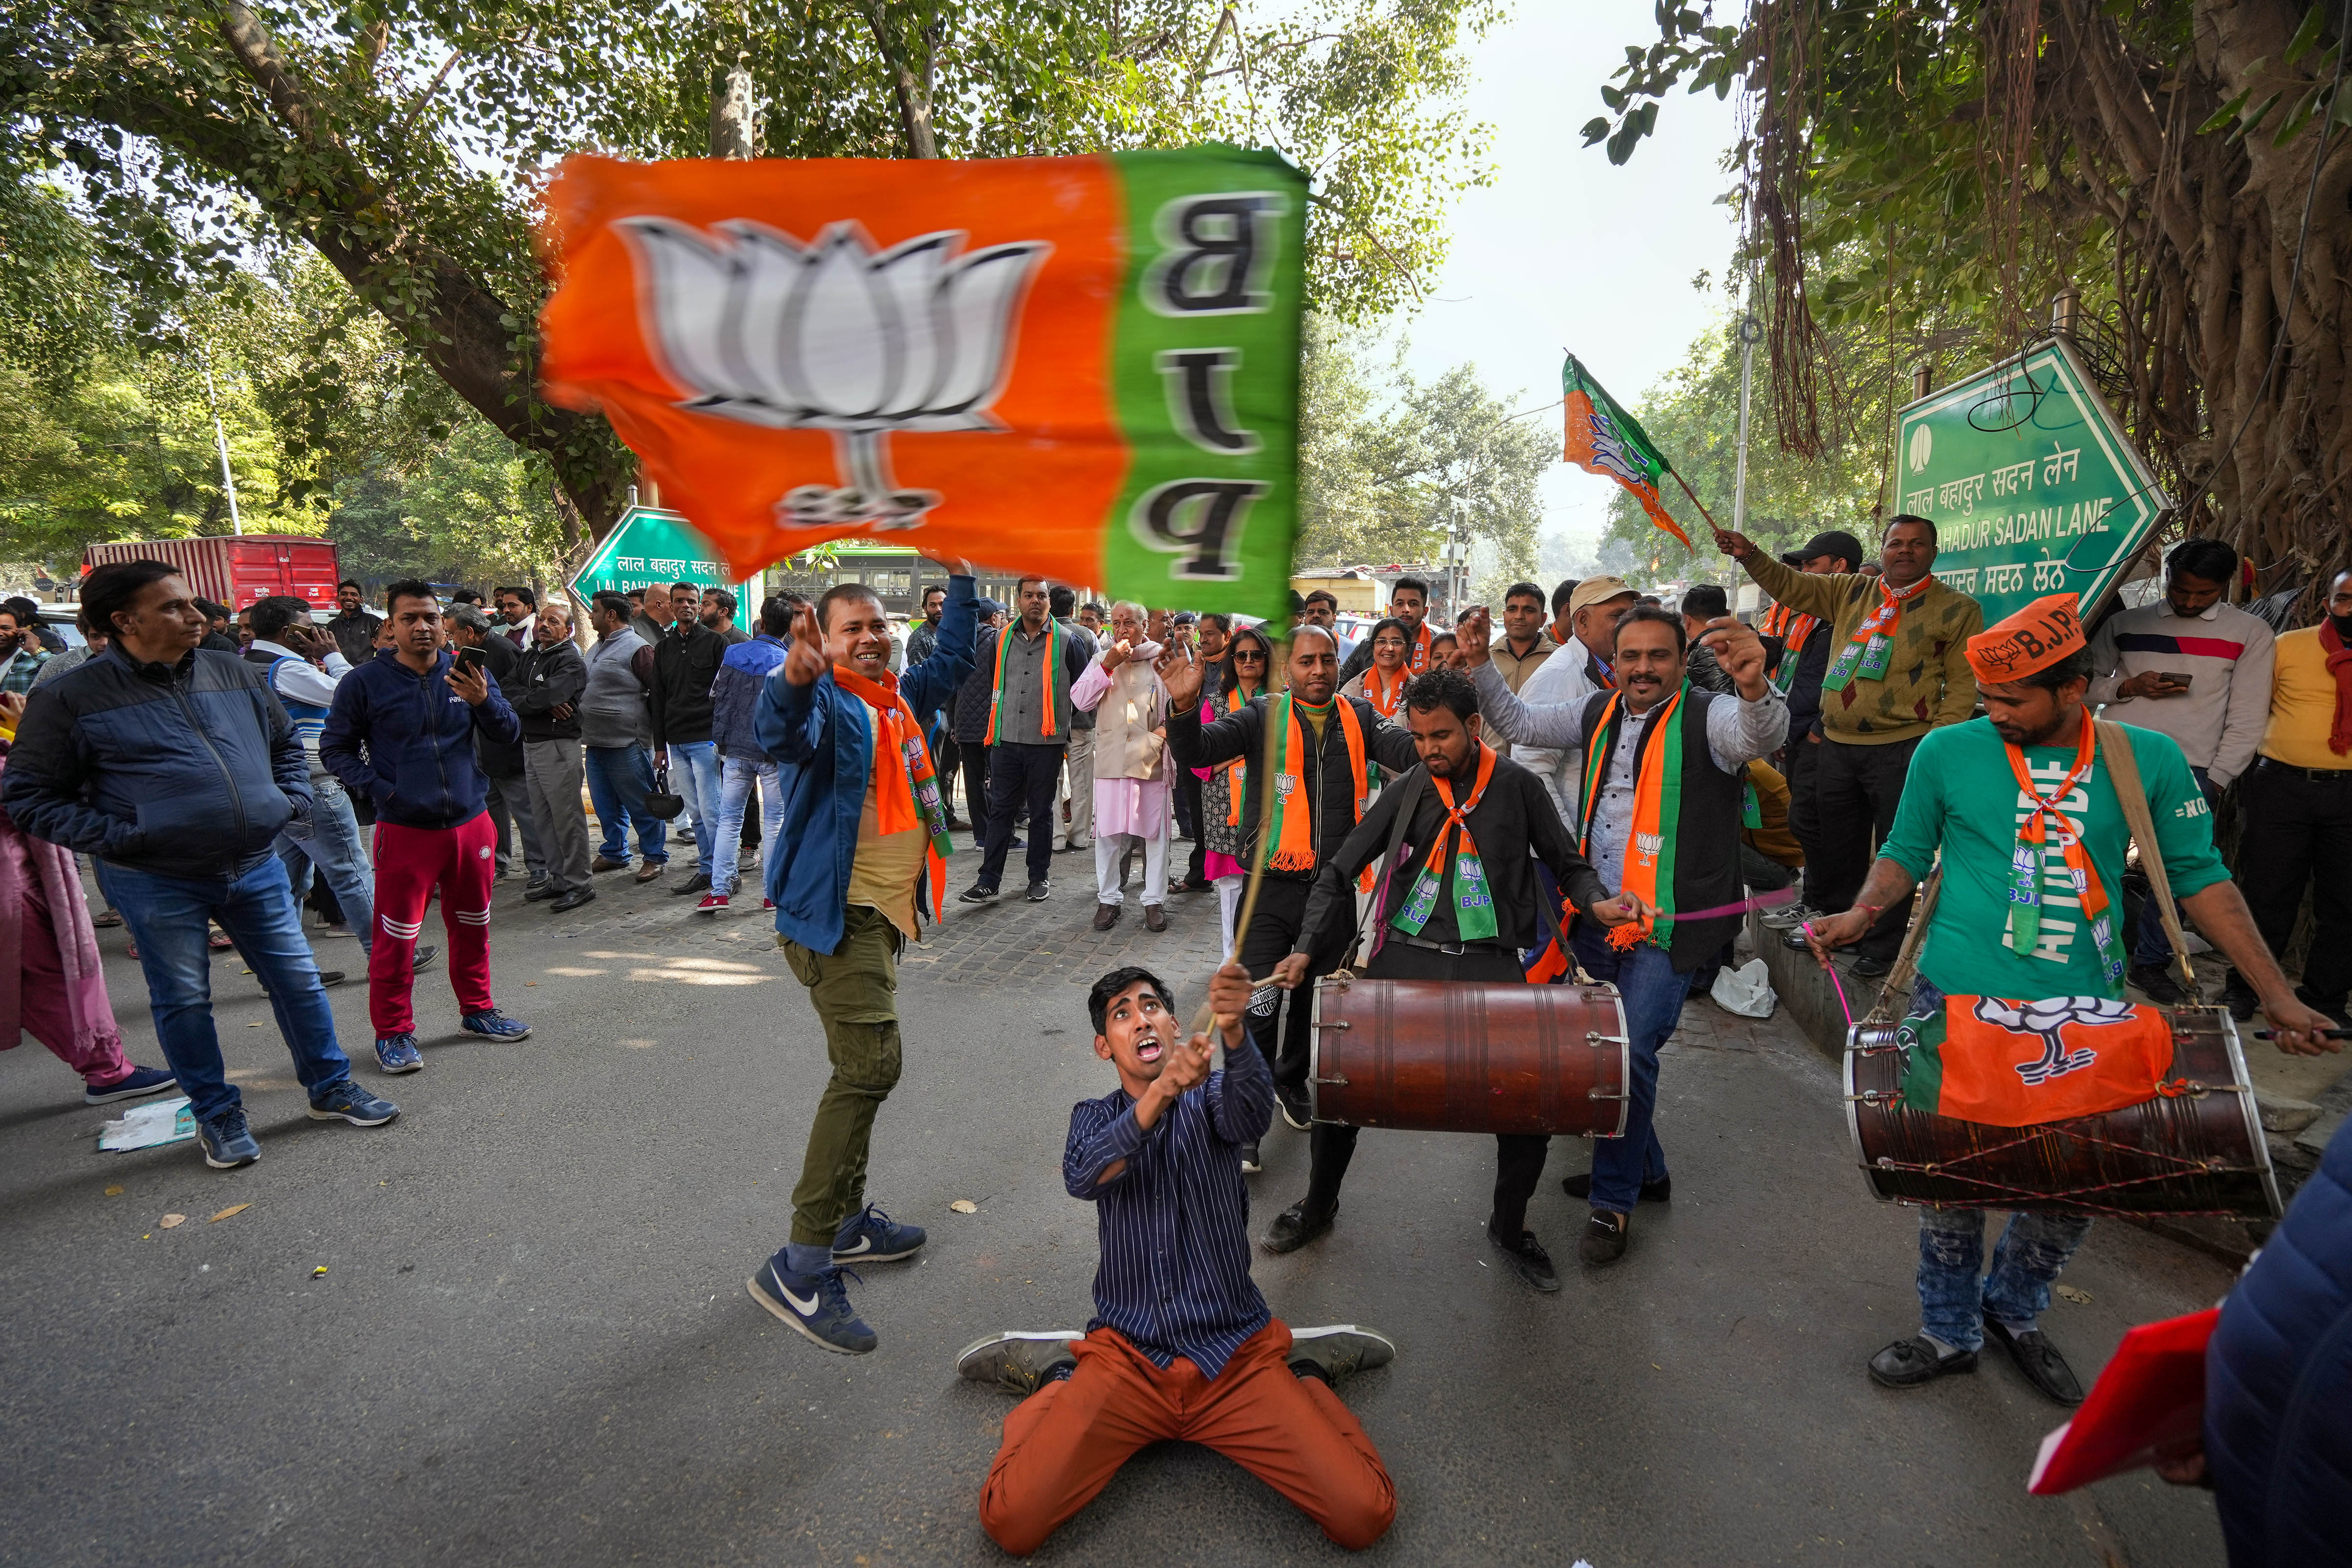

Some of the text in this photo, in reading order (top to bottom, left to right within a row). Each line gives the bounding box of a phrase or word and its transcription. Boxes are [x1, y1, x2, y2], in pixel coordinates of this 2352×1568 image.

[1907, 440, 2081, 516] लाल बहादुर सदन लेन
[1936, 497, 2113, 554] AHADUR SADAN LANE
[616, 557, 644, 572] लाल
[649, 558, 686, 579] बहादुर
[690, 561, 717, 575] सदन
[1414, 642, 1424, 669] BJP
[930, 819, 947, 836] BJ
[1461, 895, 1491, 908] BJP
